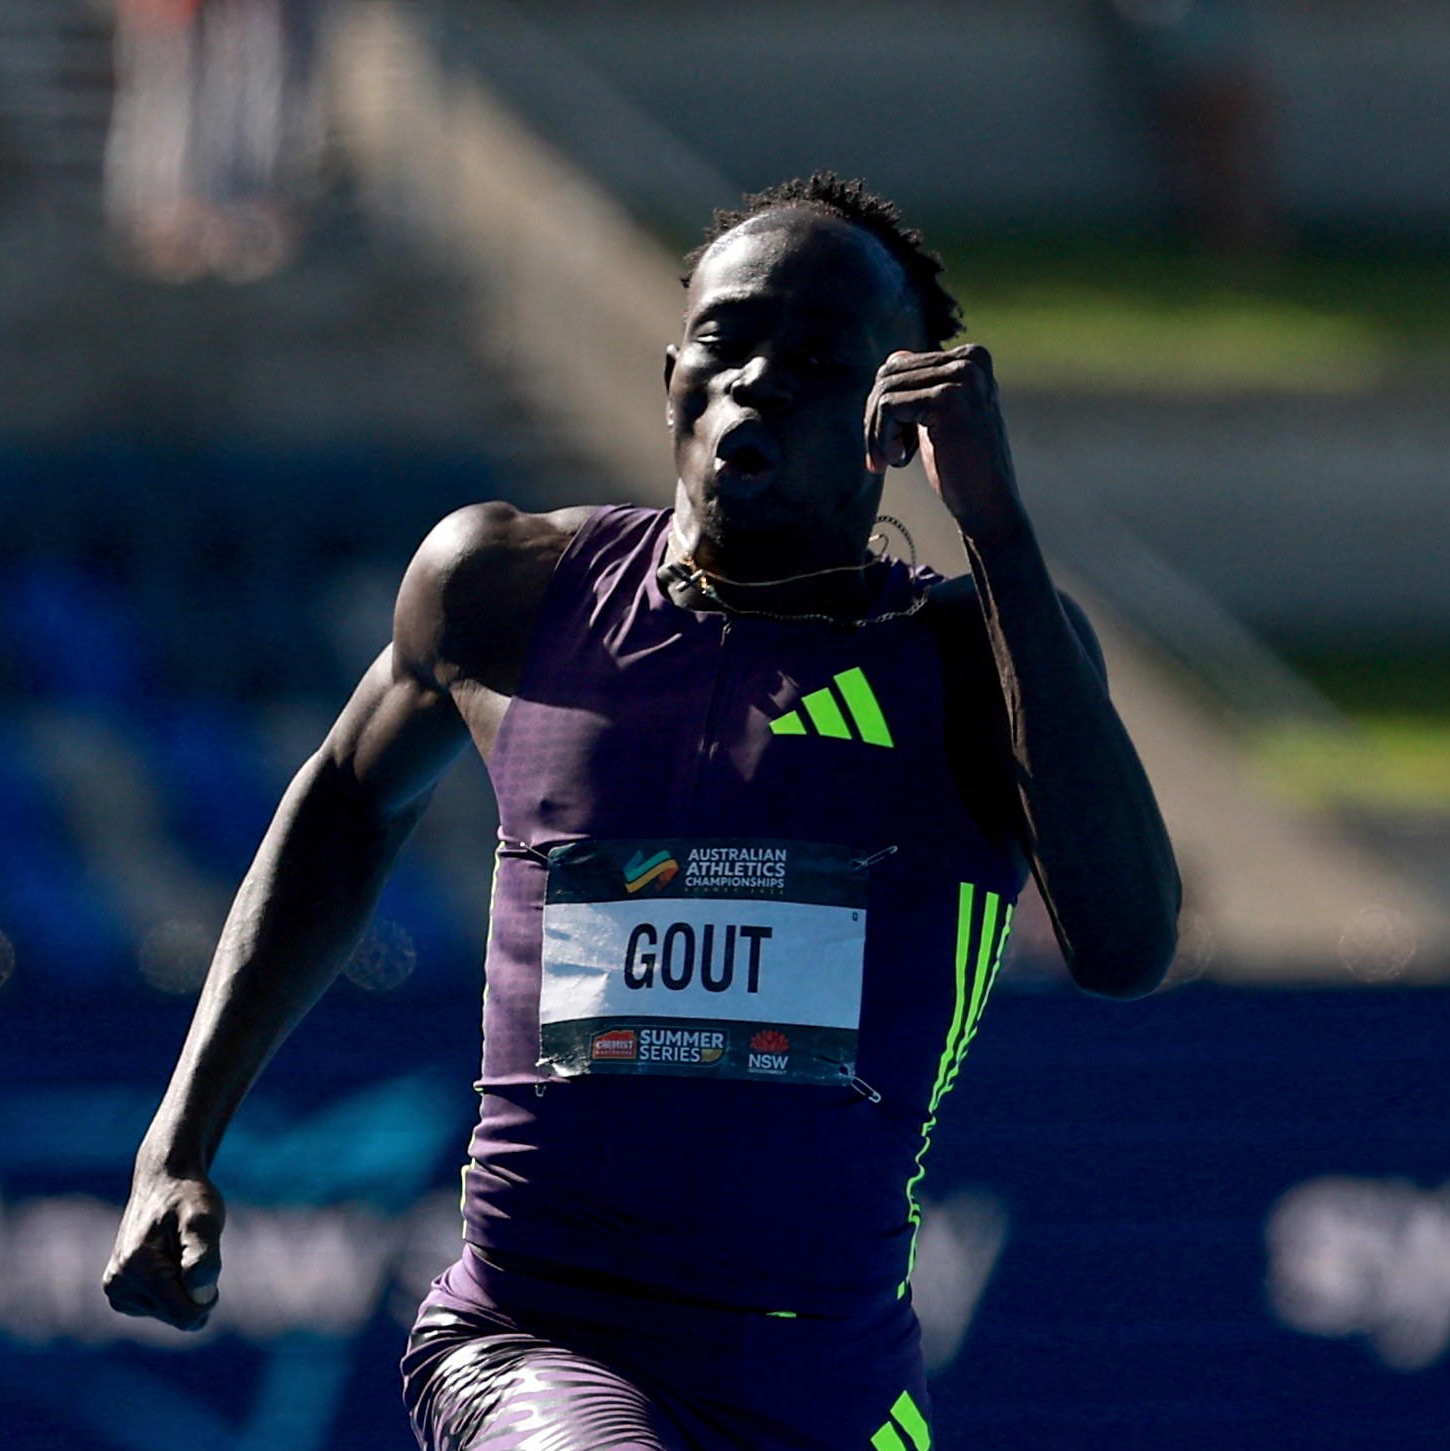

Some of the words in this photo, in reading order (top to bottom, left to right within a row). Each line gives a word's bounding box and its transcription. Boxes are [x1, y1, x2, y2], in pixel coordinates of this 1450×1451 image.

[688, 847, 788, 861] AUSTRALIAN
[685, 861, 787, 878] ATHLETICS
[684, 877, 785, 889] CHAMPIONSHIPS
[623, 921, 773, 993] GOUT
[639, 1029, 724, 1049] SUMMER
[639, 1046, 701, 1063] SERIES
[748, 1053, 789, 1070] NSW
